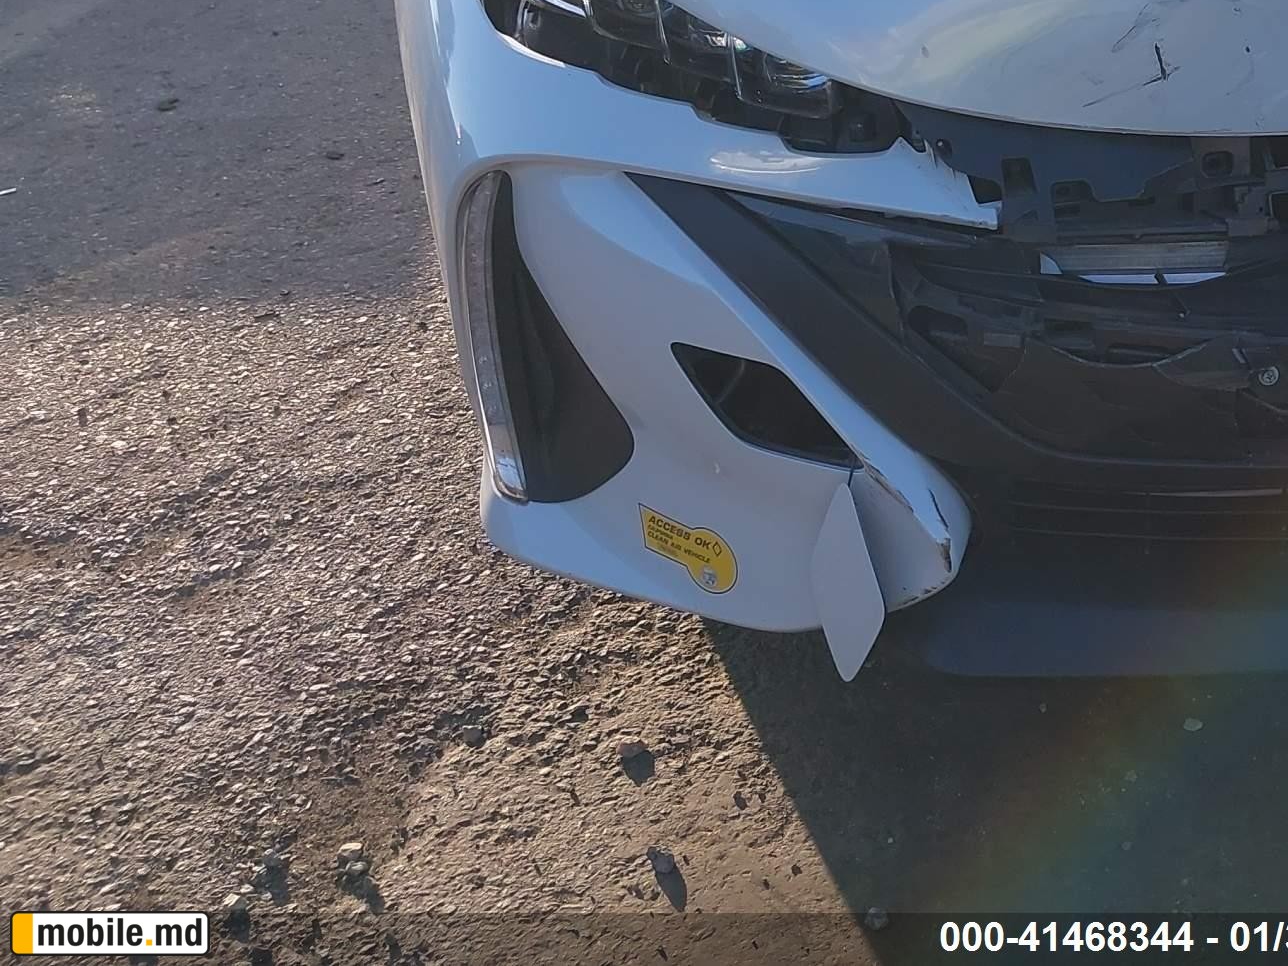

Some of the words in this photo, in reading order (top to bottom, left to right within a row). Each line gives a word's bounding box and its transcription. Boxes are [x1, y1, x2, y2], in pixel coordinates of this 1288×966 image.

[647, 530, 670, 545] CLEAN
[648, 516, 692, 541] ACCESS
[694, 537, 712, 550] OK
